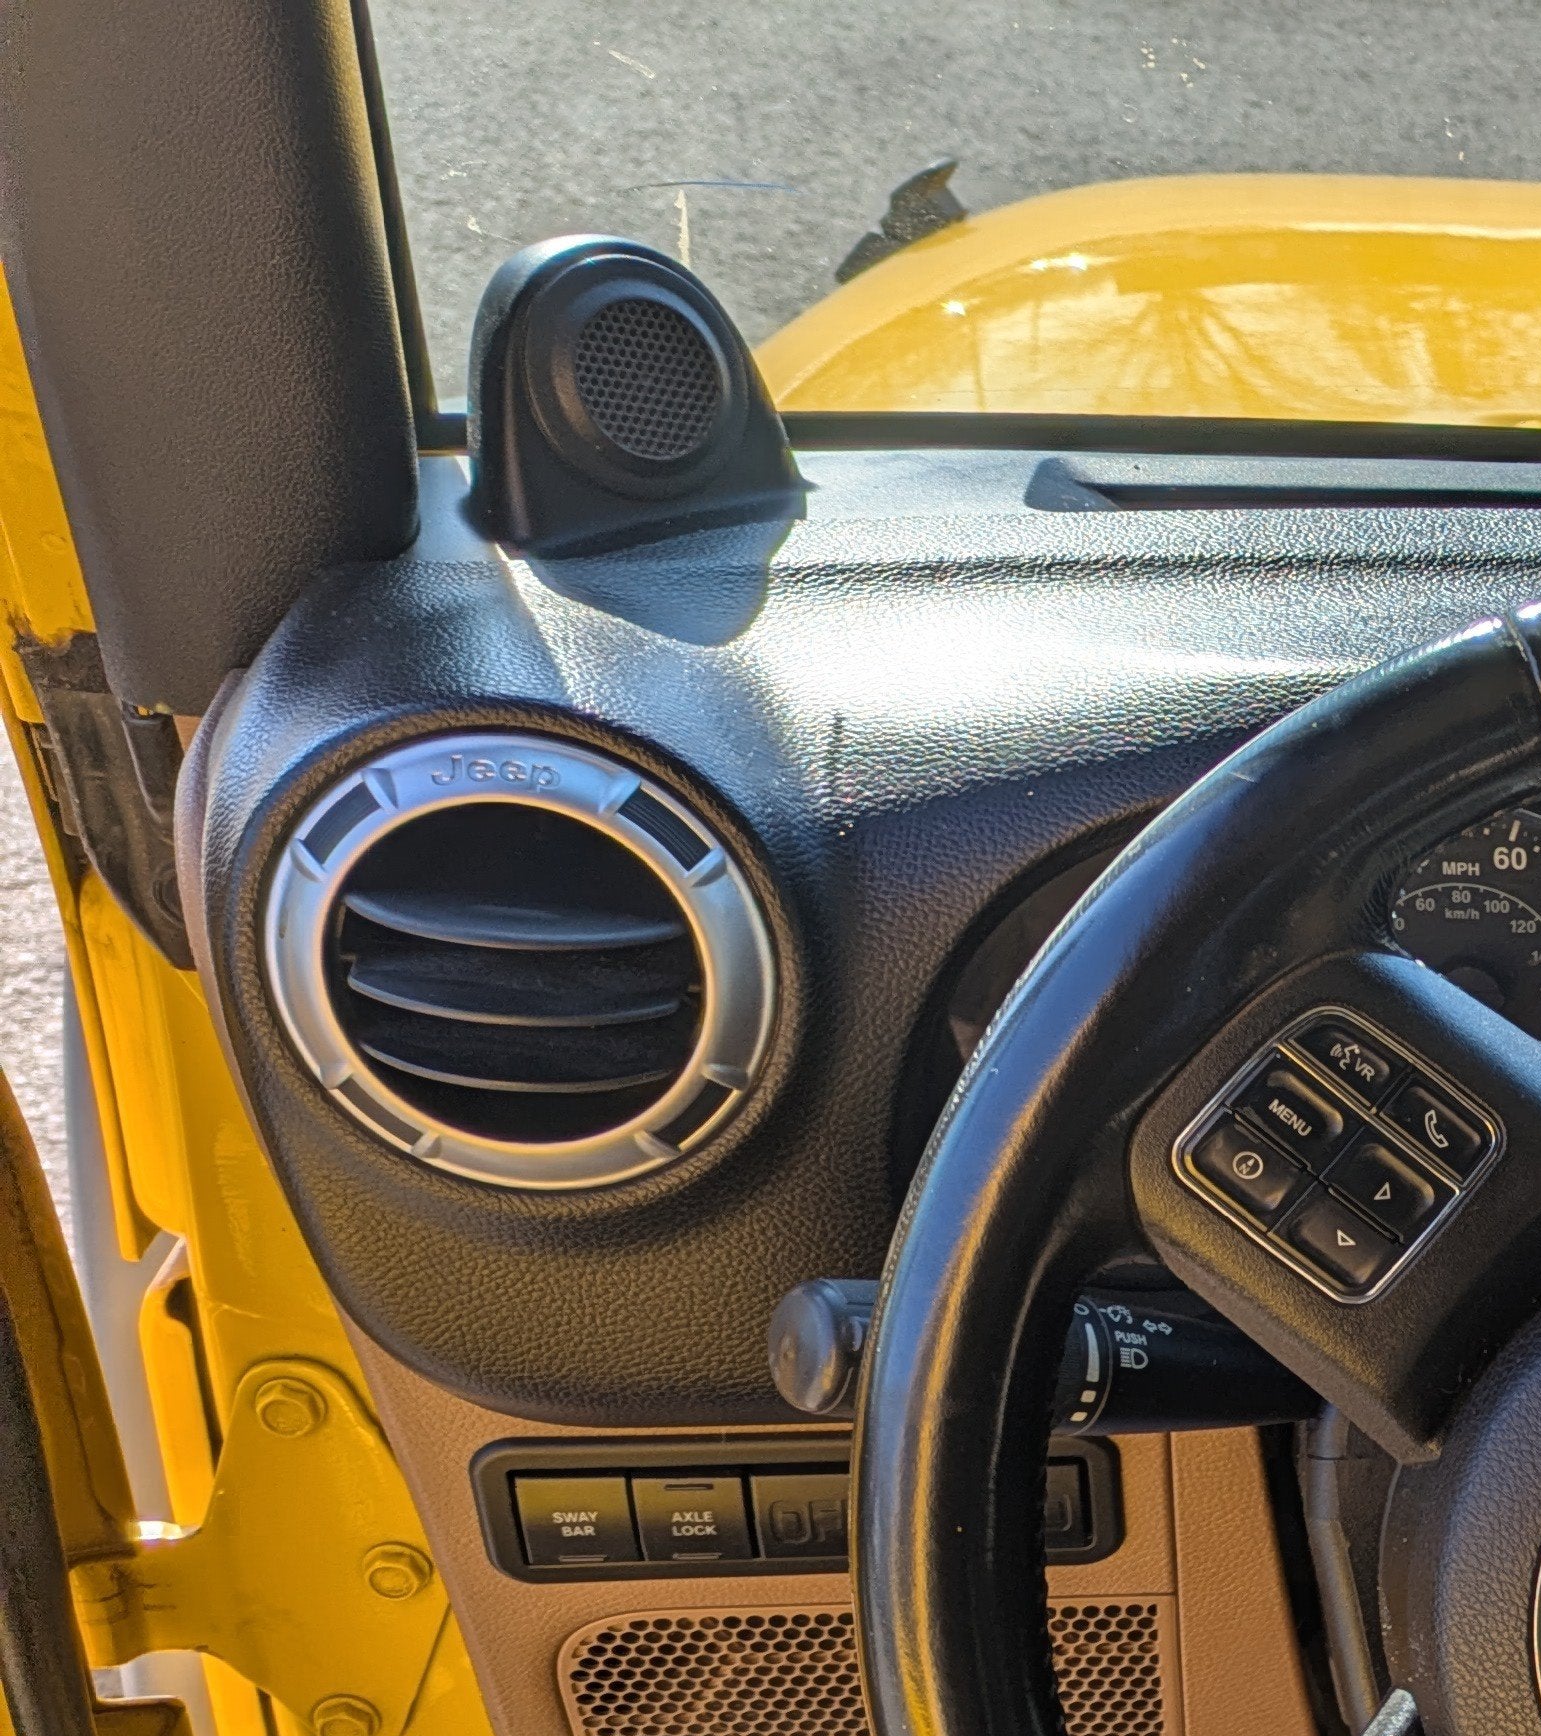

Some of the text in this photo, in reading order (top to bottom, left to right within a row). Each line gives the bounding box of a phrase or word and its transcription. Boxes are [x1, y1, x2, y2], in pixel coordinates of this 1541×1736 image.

[431, 753, 562, 792] Jeep
[1493, 847, 1527, 871] 60
[1442, 861, 1480, 876] MPH
[1451, 890, 1471, 903] 80
[1415, 897, 1435, 912] 60
[1484, 900, 1510, 914] 100
[1445, 907, 1480, 920] km/h
[1510, 920, 1537, 934] 120
[1353, 1056, 1376, 1084] VR
[1267, 1097, 1312, 1138] MENU
[1114, 1329, 1148, 1346] PUSH
[552, 1510, 598, 1525] SWAY
[671, 1509, 715, 1524] AXLE
[561, 1523, 597, 1538] BAR
[671, 1522, 717, 1537] LOCK
